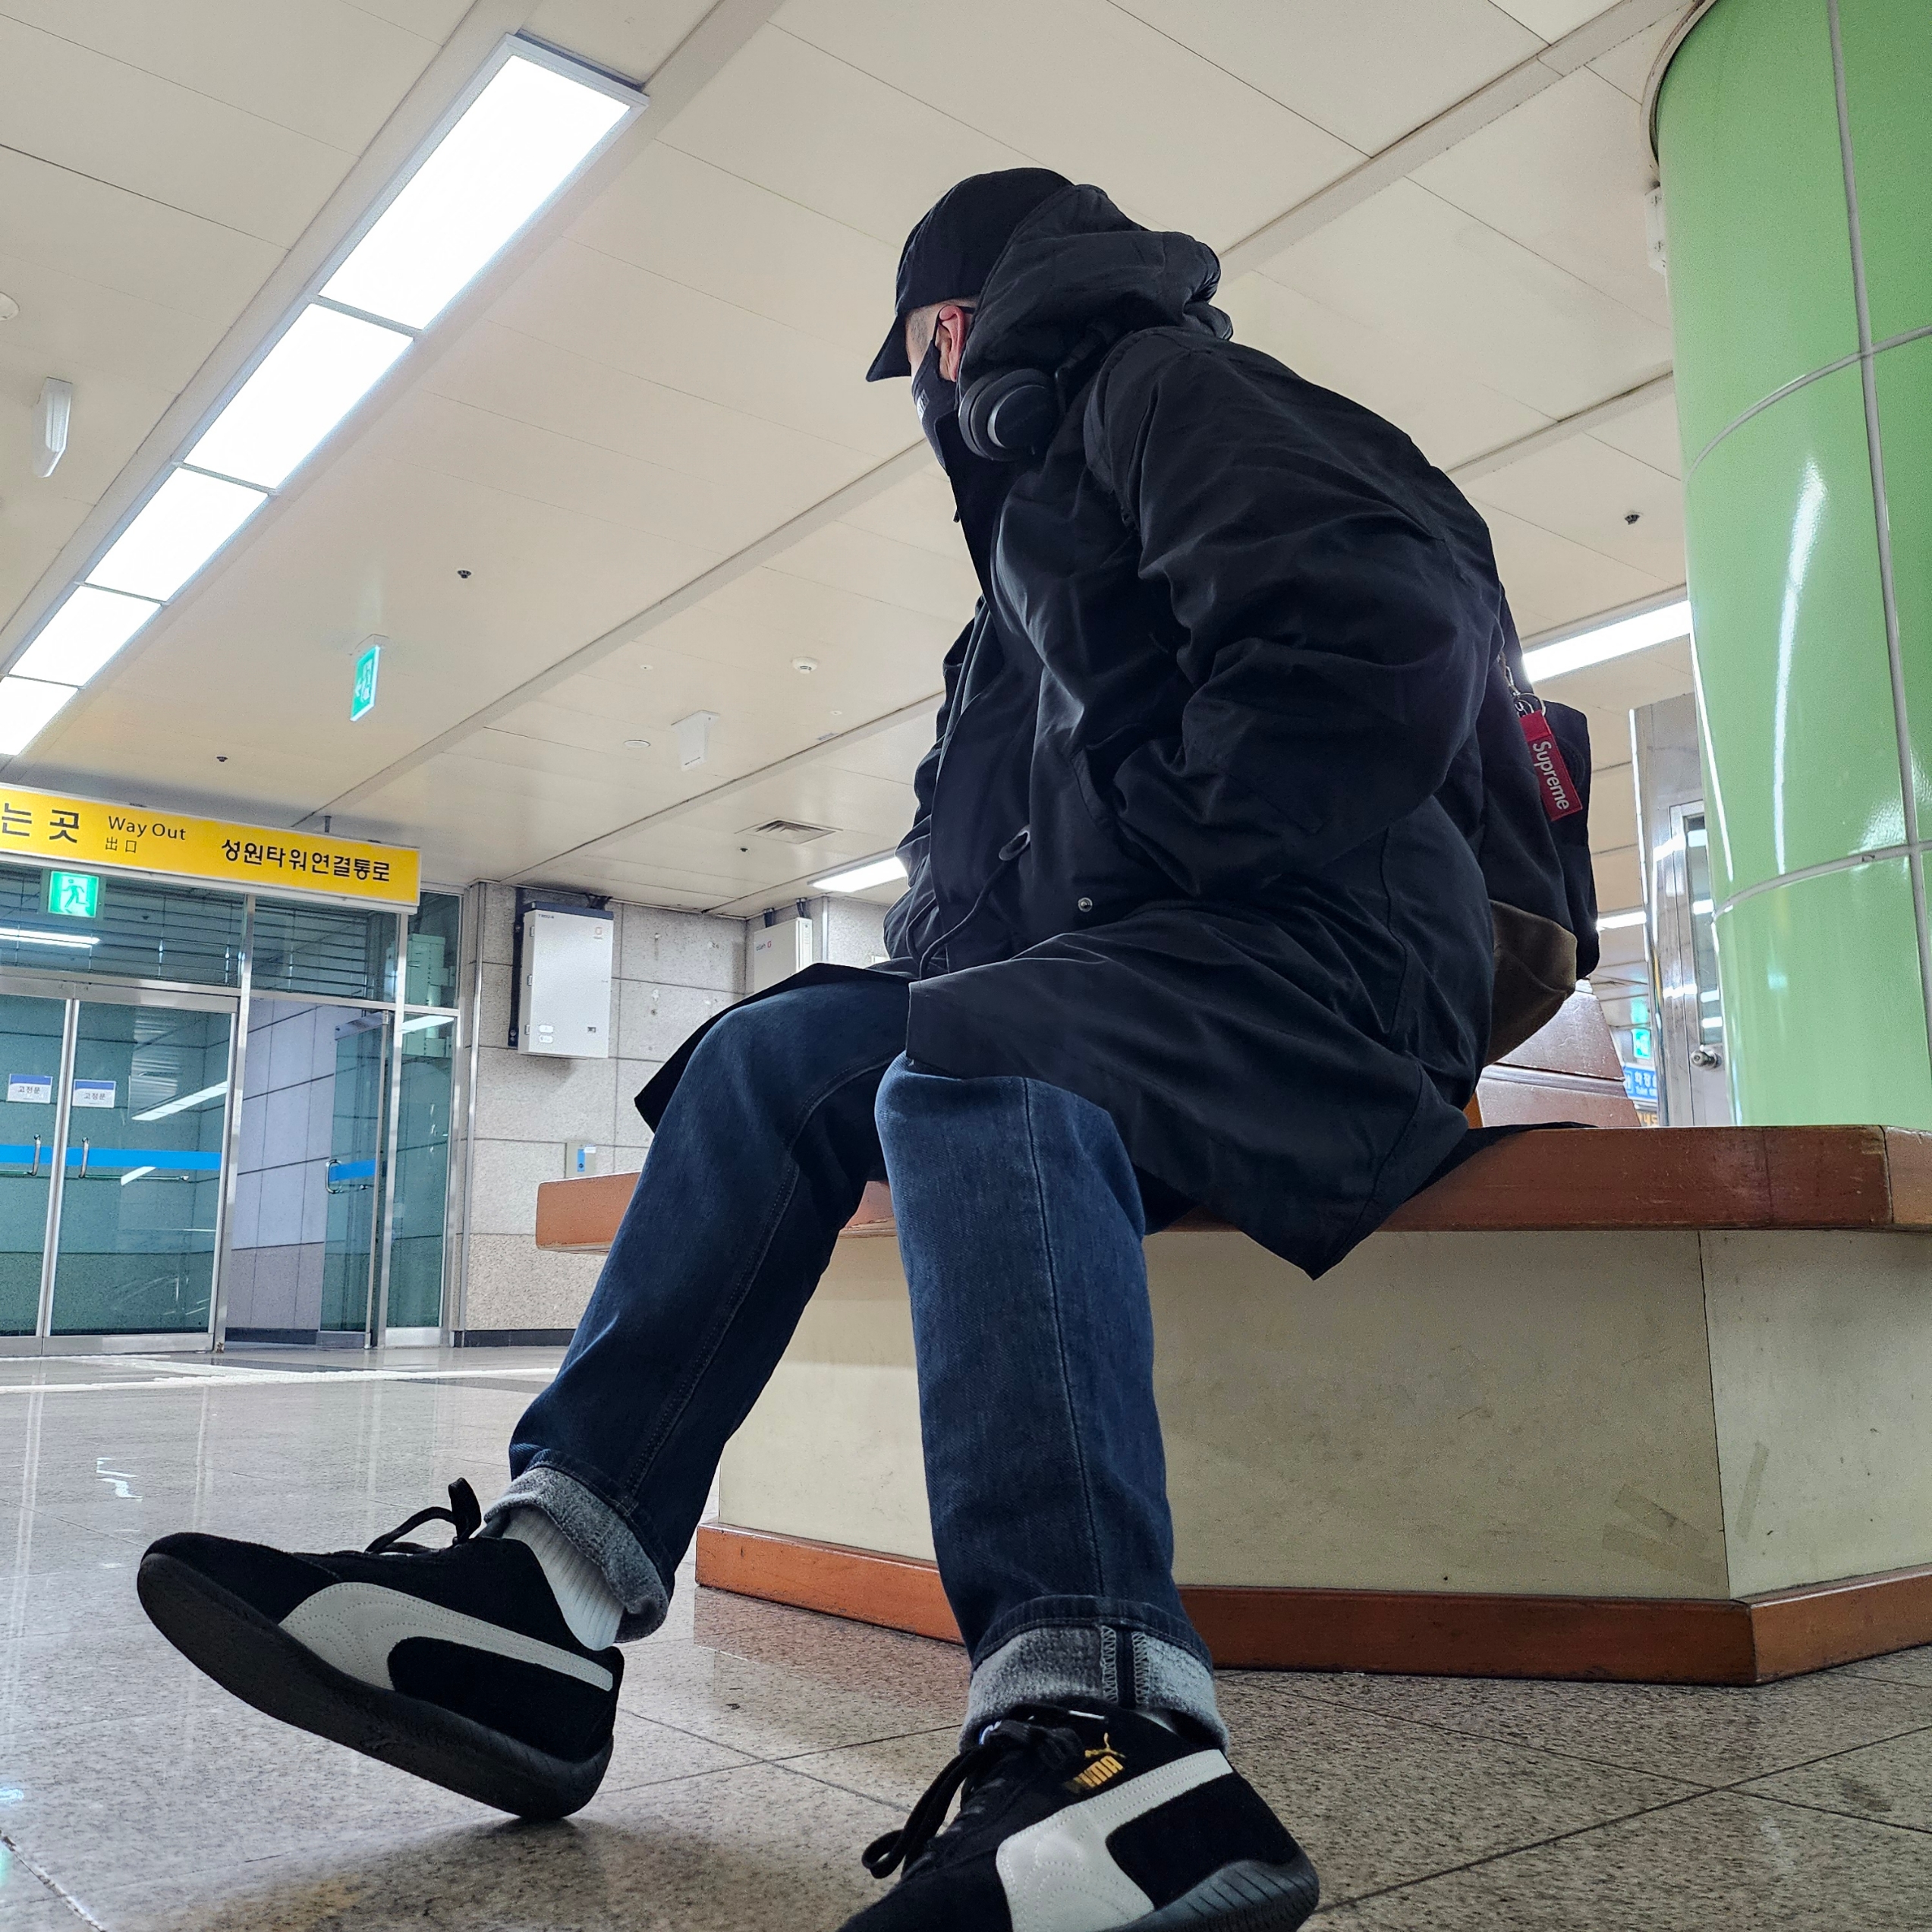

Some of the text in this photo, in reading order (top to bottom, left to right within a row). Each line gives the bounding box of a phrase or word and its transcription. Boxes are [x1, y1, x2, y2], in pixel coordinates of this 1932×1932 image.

[1533, 741, 1570, 810] Supreme
[2, 803, 80, 844] 는 곳
[109, 816, 187, 841] Way Out
[105, 836, 137, 854] 出口
[221, 839, 390, 883] 성원타워연결통로
[17, 1085, 41, 1094] 고정문
[83, 1092, 106, 1100] 고정문
